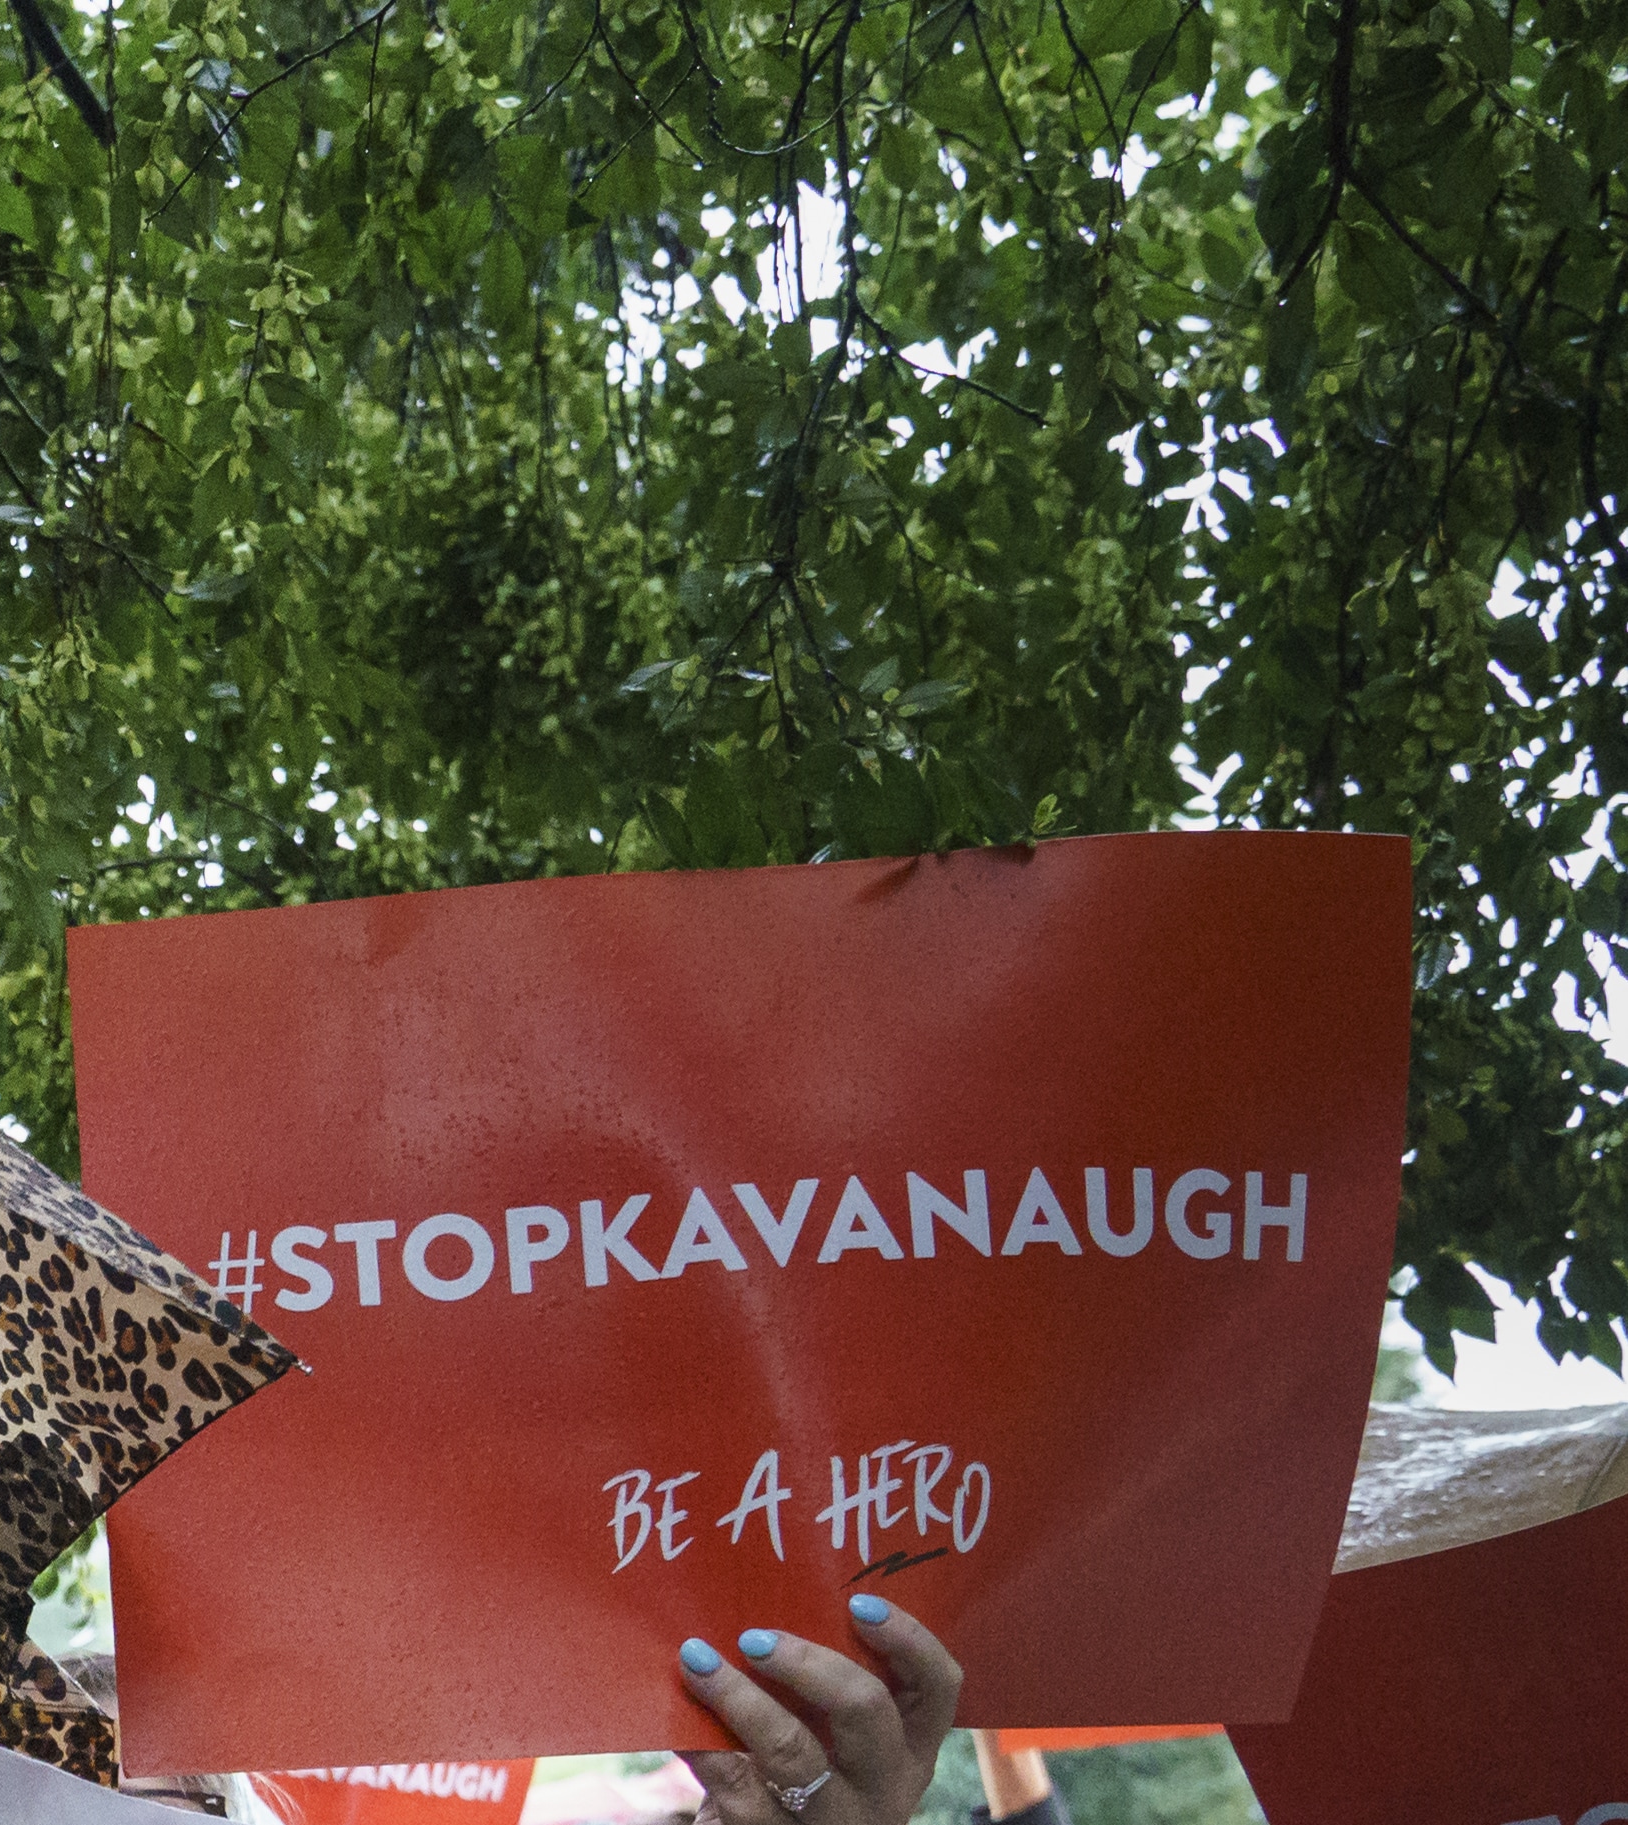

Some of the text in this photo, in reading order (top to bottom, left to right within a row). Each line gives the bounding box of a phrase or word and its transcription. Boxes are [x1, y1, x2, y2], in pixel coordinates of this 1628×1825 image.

[208, 1166, 1309, 1314] #STOPKAVANAUGH
[601, 1438, 992, 1575] BE A HERO
